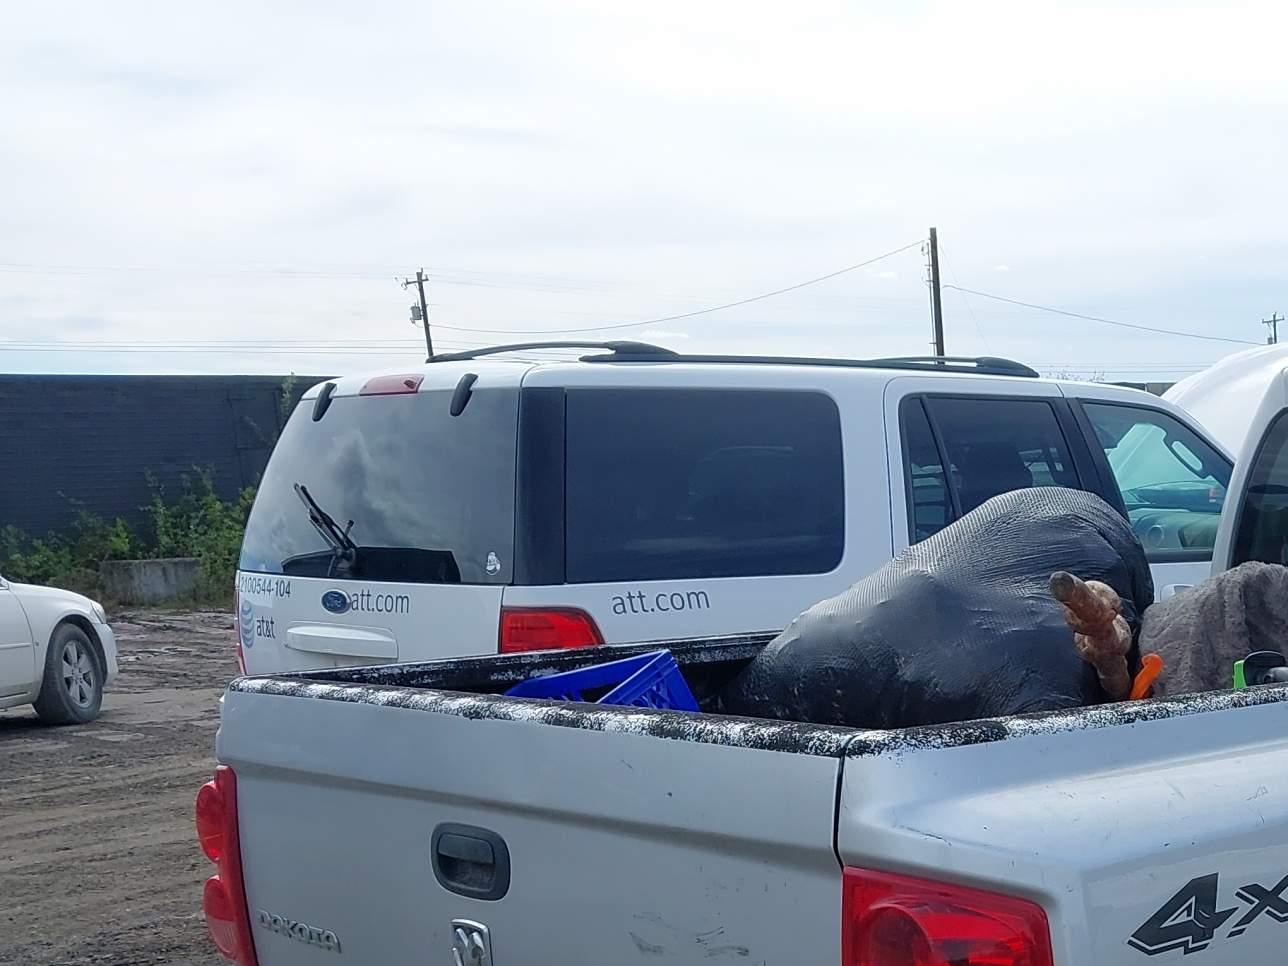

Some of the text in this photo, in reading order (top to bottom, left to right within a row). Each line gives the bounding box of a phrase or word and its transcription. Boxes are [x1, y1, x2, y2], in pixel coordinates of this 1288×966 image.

[351, 589, 410, 614] att.com
[611, 590, 710, 615] att.com
[256, 616, 275, 639] at&t
[257, 907, 342, 954] DAKOTA
